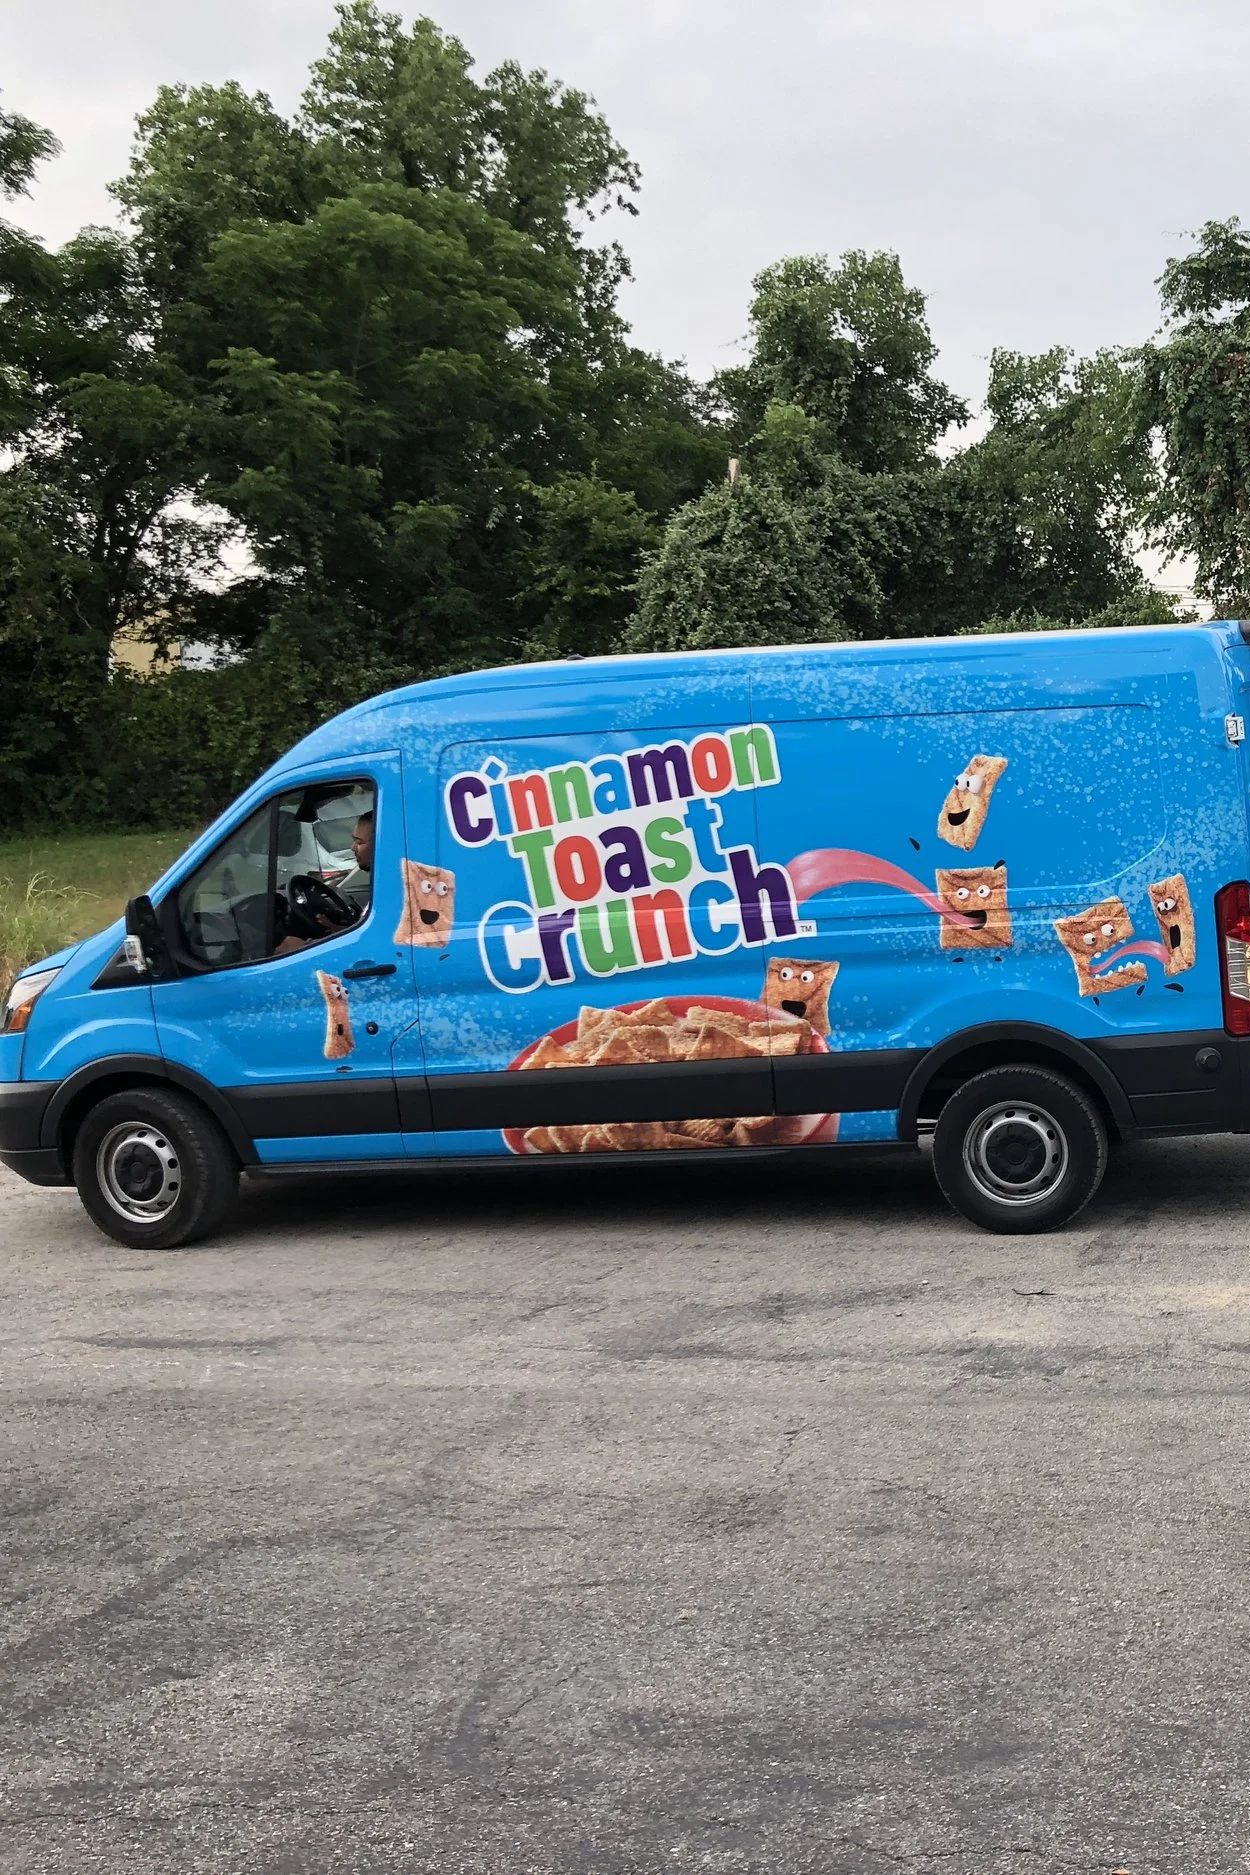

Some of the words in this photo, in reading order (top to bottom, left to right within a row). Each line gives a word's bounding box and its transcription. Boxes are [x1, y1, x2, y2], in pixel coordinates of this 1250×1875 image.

[448, 726, 778, 843] Cinnamon
[511, 798, 729, 909] Toast
[483, 849, 797, 989] Crunch
